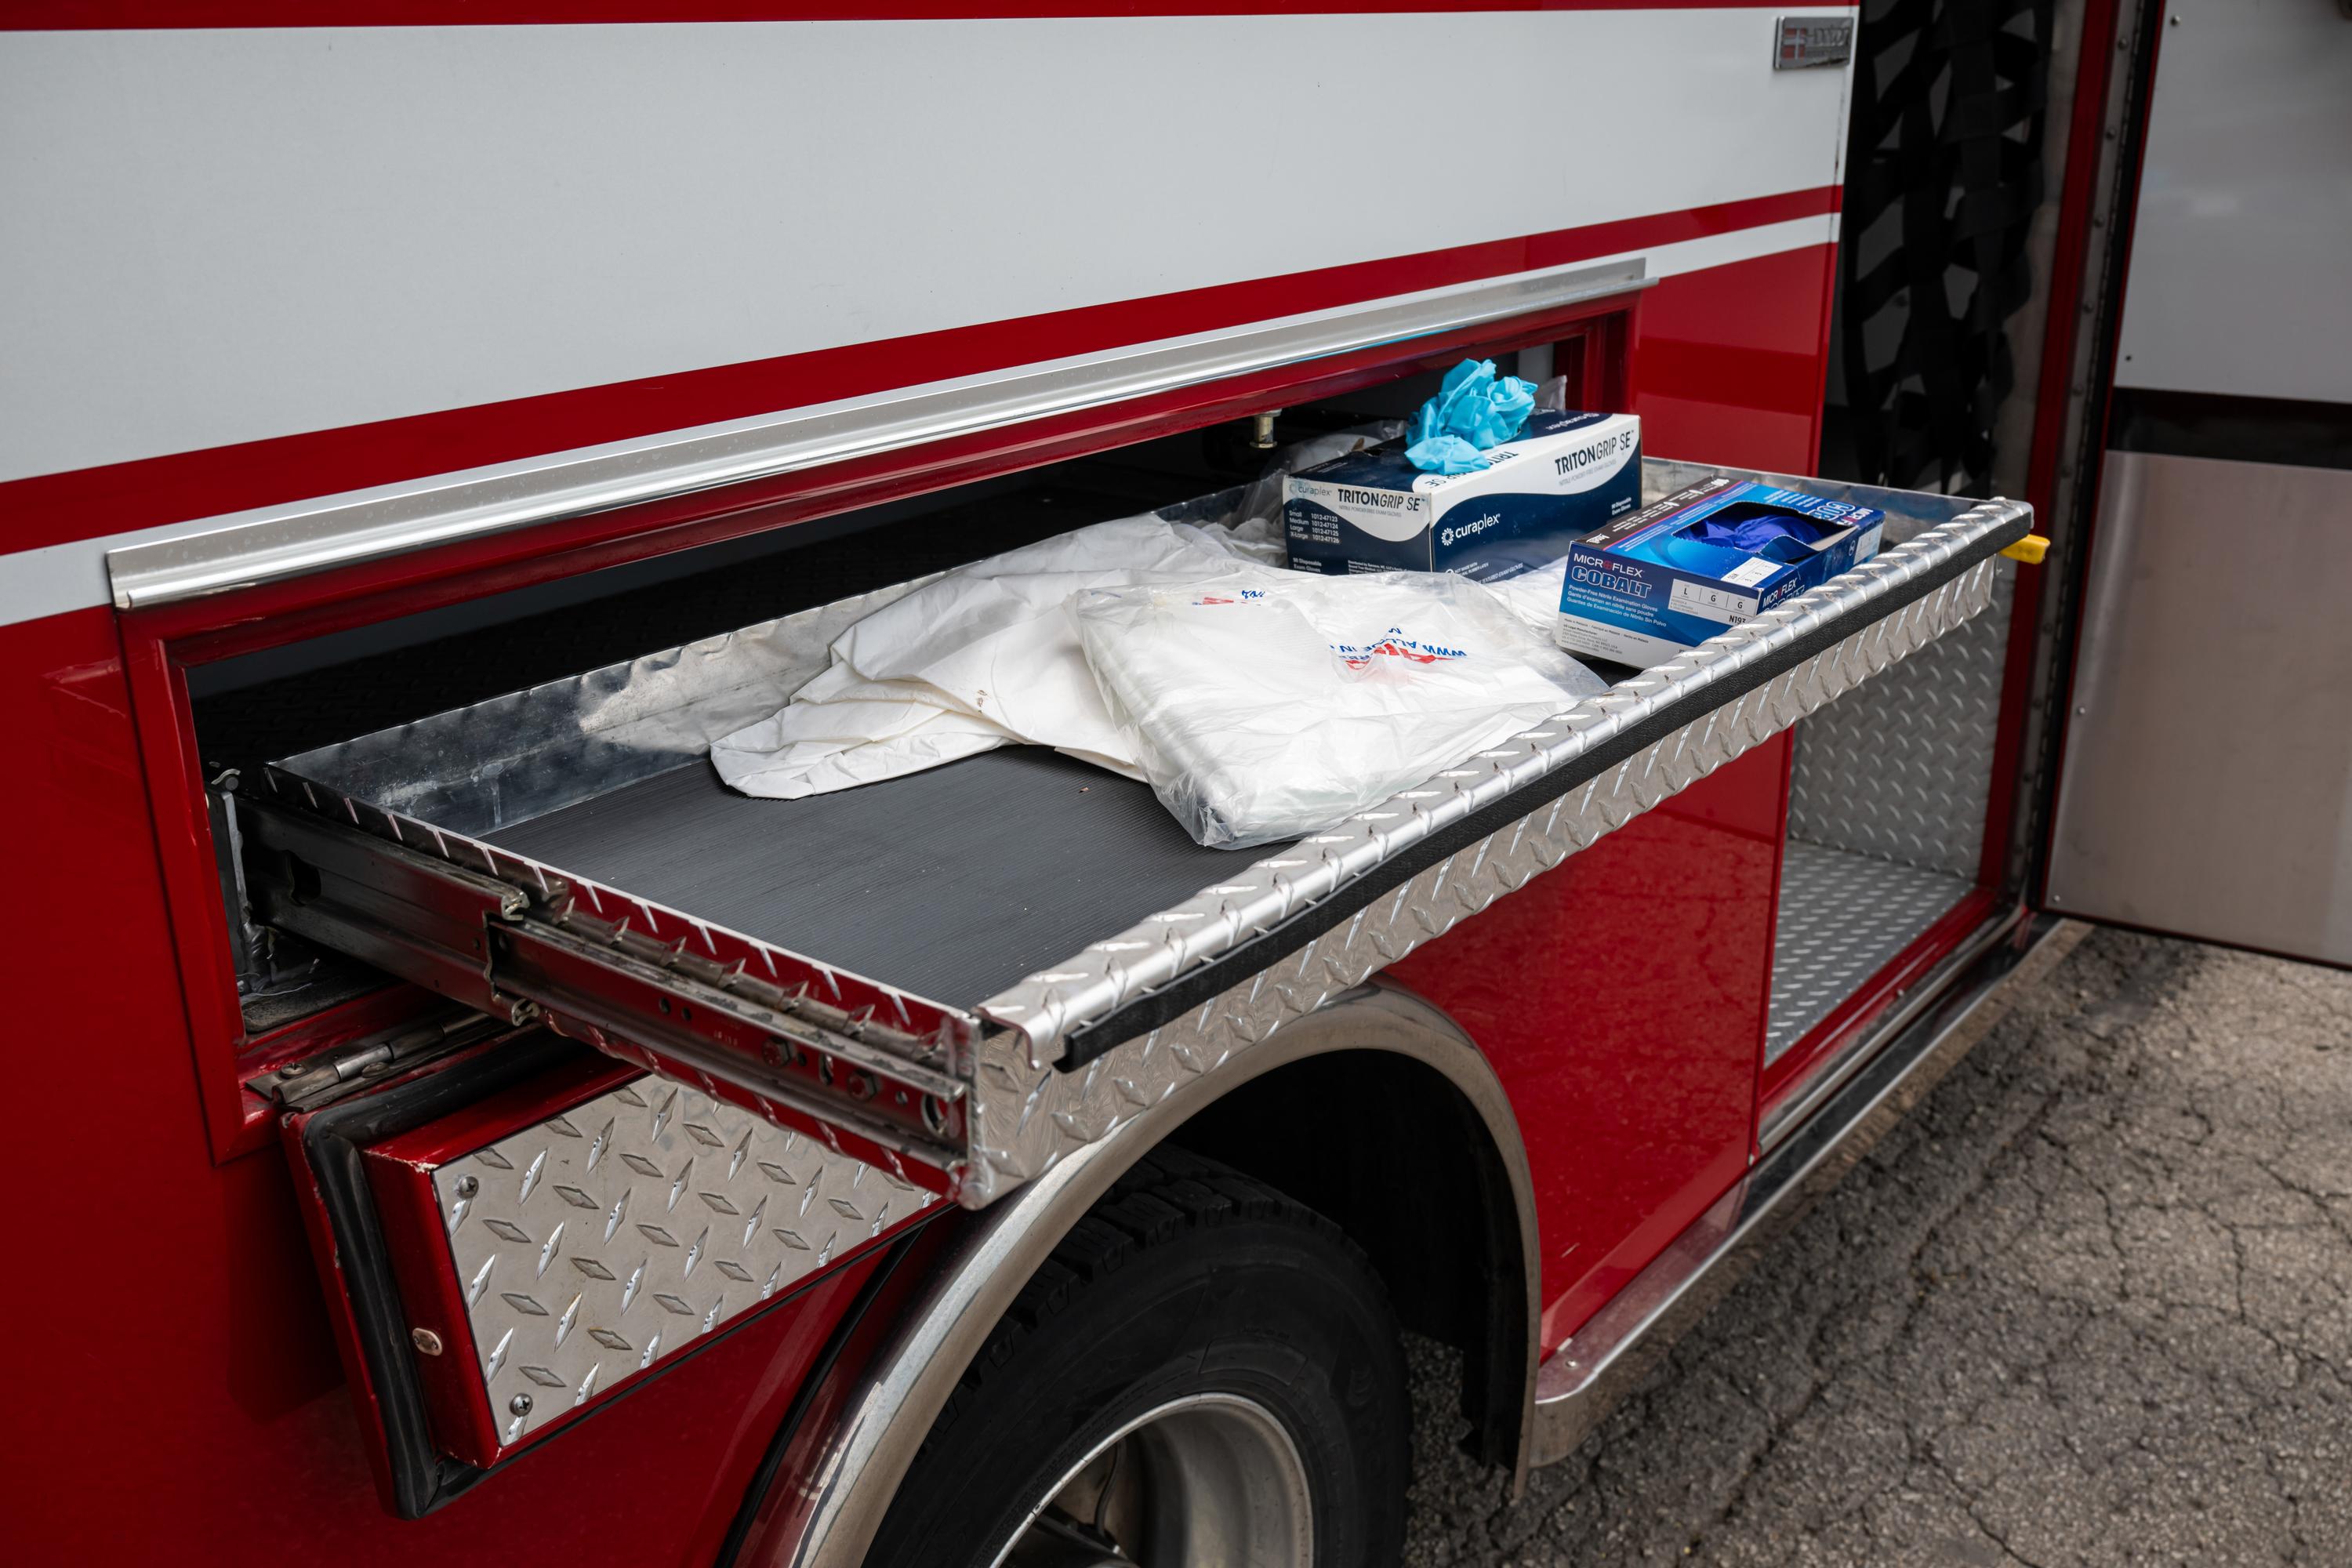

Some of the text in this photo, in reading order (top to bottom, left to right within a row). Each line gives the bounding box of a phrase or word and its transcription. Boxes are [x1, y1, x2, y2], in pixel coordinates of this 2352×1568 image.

[1555, 437, 1617, 476] TRITONGRIP
[1298, 485, 1332, 496] curaplex
[1338, 488, 1403, 509] TRITONGRIP
[1311, 513, 1338, 522] 1012-47123
[1312, 521, 1338, 529] 1012-47124
[1455, 514, 1500, 538] curaplex
[1290, 532, 1308, 540] X-Large
[1312, 528, 1339, 536] 1012-47125
[1573, 553, 1643, 578] MICROFLEX
[1571, 565, 1652, 598] COBALT
[1683, 587, 1688, 596] L
[1569, 584, 1598, 597] Powder-Free
[1613, 596, 1641, 608] Examination
[1642, 603, 1658, 612] Gloves
[1762, 578, 1798, 608] MICROFLEX
[1566, 597, 1585, 606] Guantes
[1593, 604, 1622, 615] Examinación
[1582, 594, 1605, 604] d'examen
[1612, 601, 1624, 610] nitrile
[1637, 608, 1654, 618] poudre
